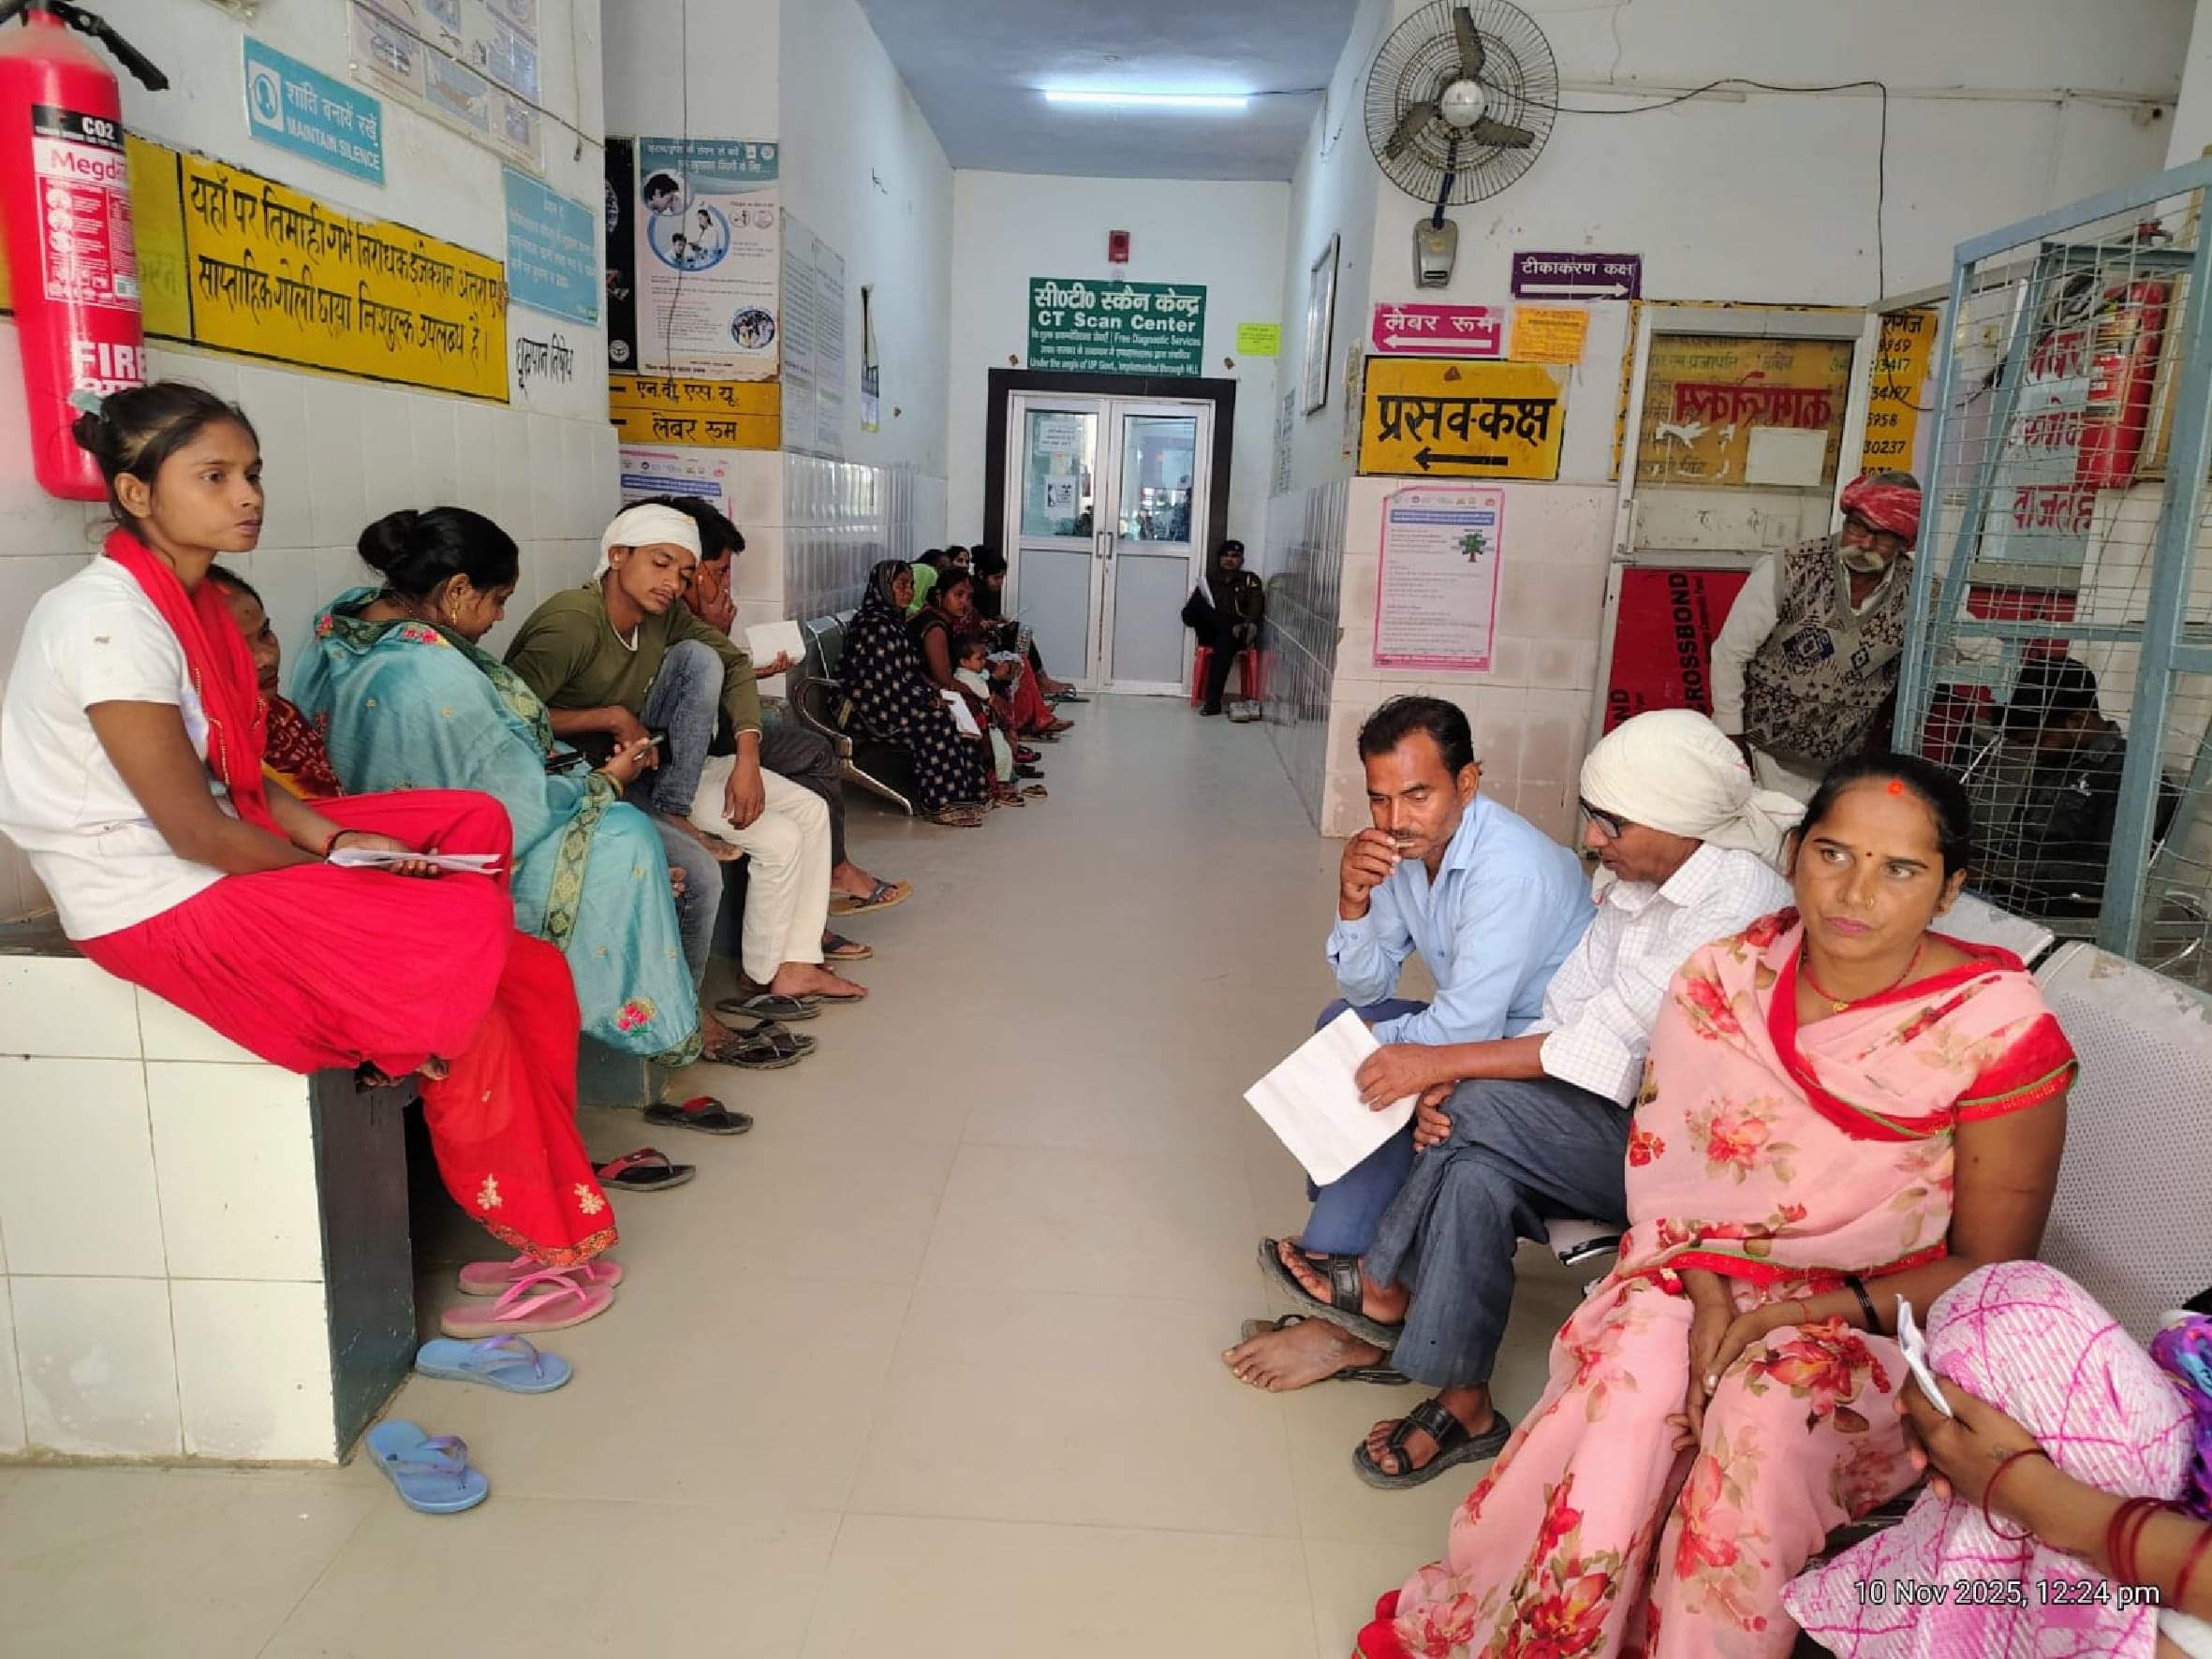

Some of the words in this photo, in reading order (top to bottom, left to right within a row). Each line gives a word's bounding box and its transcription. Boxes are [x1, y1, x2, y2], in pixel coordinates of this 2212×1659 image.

[81, 116, 115, 140] CO2
[287, 117, 337, 154] MAINTAIN
[338, 139, 380, 170] SILENCE
[233, 189, 259, 239] पर
[262, 185, 325, 265] तिमाही
[1603, 261, 1634, 276] कक्ष
[1100, 285, 1151, 312] स्कैन
[1038, 311, 1065, 327] CT
[1074, 311, 1122, 329] Scan
[1130, 314, 1196, 332] Center
[1383, 308, 1439, 331] लेबर
[1450, 315, 1497, 332] रूम
[1114, 332, 1131, 344] Free
[652, 412, 698, 442] लेबर
[705, 420, 737, 442] रूम
